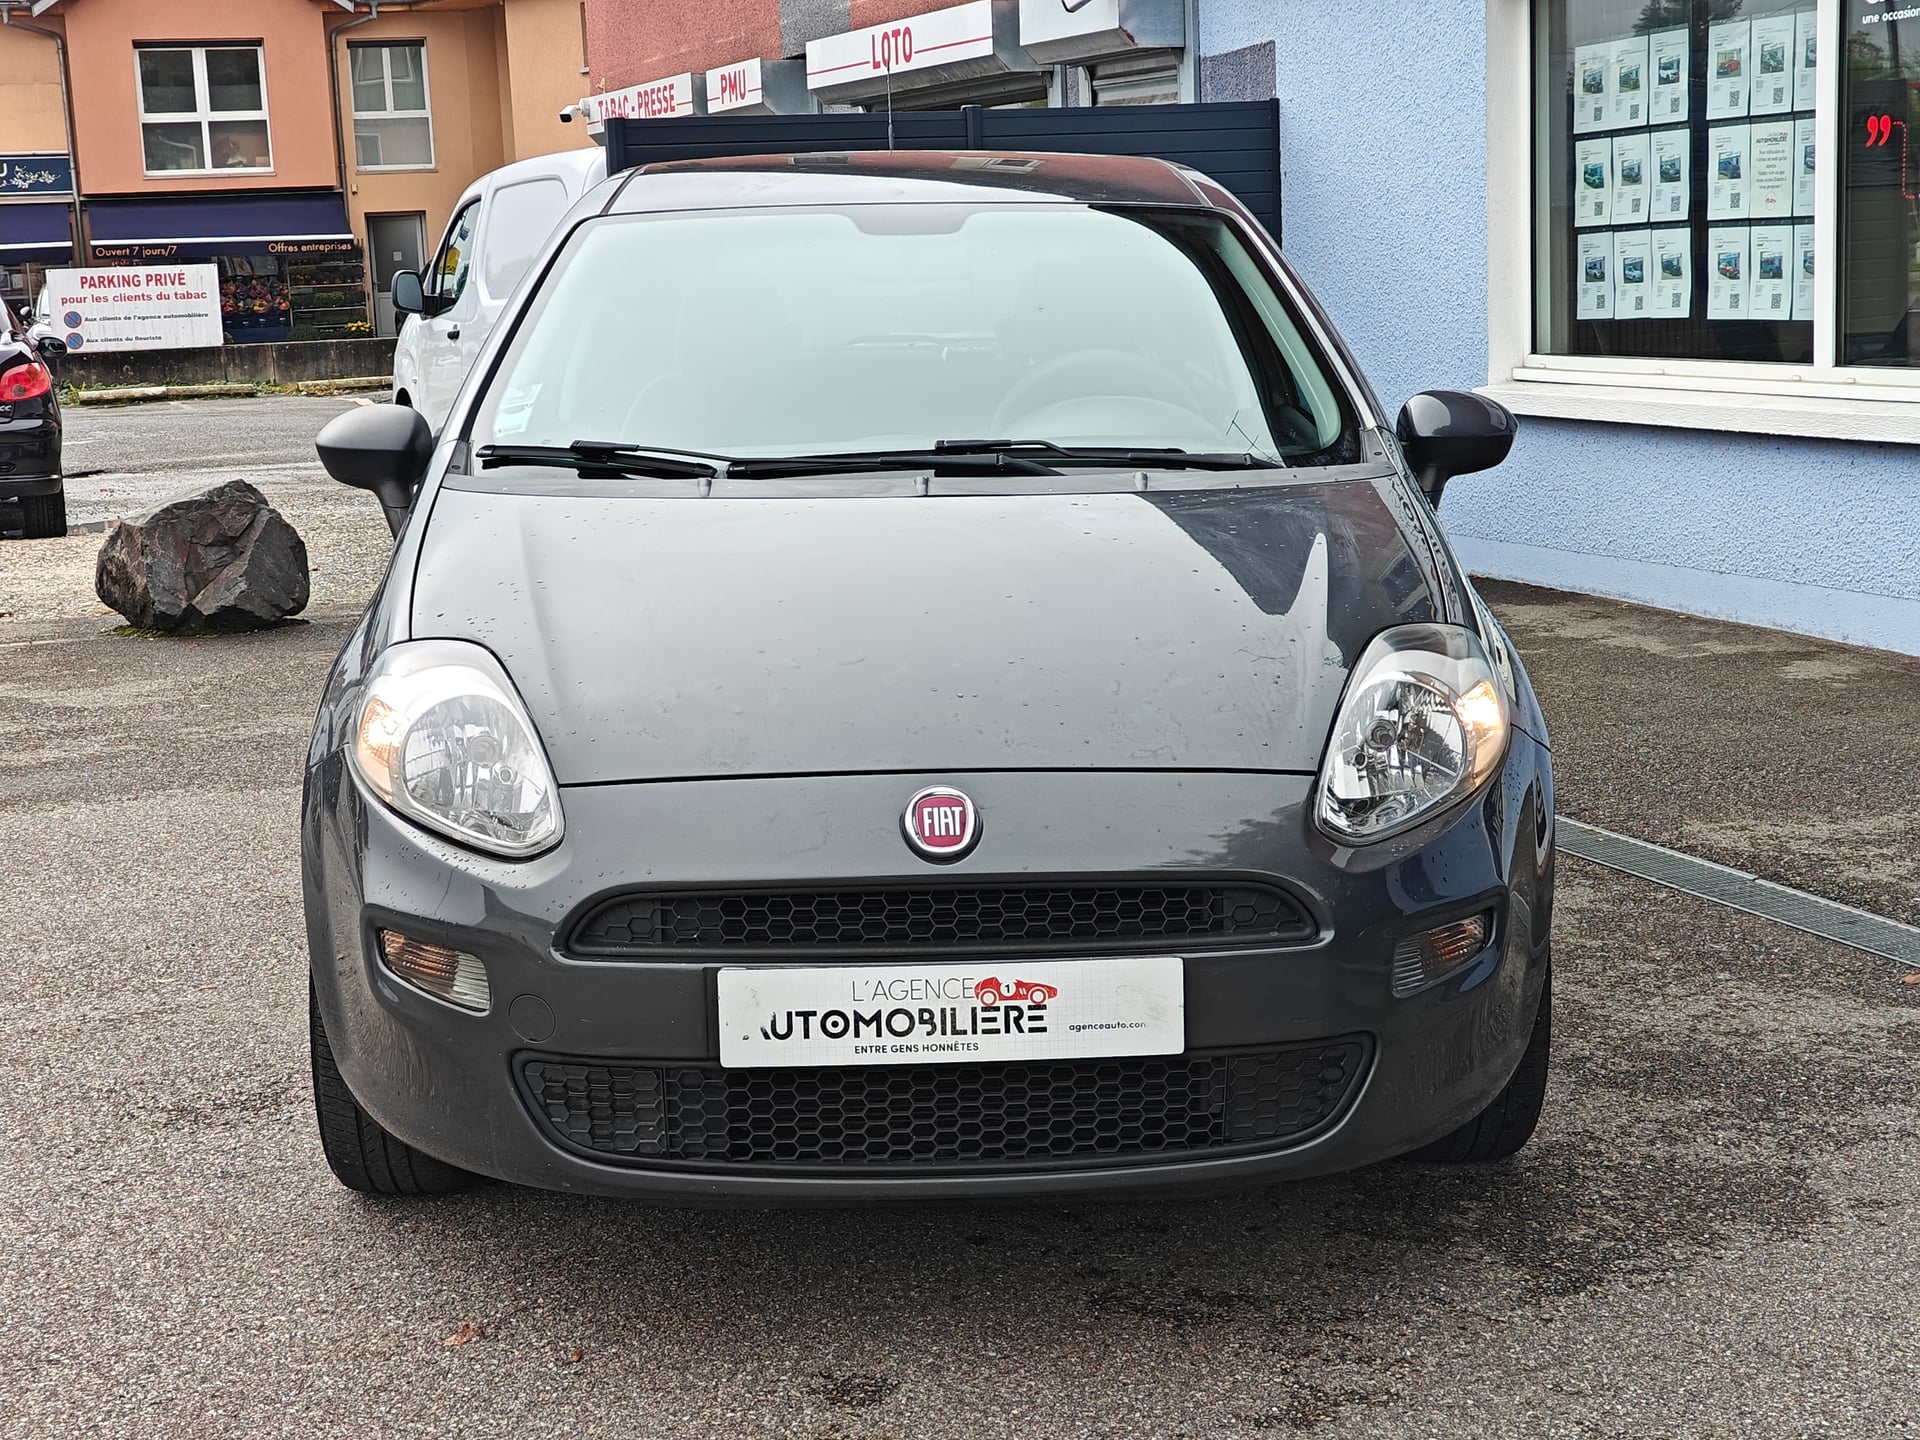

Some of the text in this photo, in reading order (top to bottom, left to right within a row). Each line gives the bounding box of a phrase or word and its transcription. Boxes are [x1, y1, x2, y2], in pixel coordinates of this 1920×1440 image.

[1862, 14, 1880, 24] une
[871, 26, 912, 70] LOTO
[721, 69, 746, 104] PMU
[637, 83, 676, 118] PRESSE
[95, 245, 178, 257] Ouvert 7 jours/7
[268, 242, 352, 253] Offres entreprises
[80, 269, 187, 290] PARKING PRIVÉ
[61, 290, 208, 306] pour les clients du tabac
[922, 806, 963, 837] FIAT
[852, 978, 975, 1001] L'AGENCE
[742, 1004, 1048, 1041] UTOMOBILIERE
[854, 1041, 979, 1054] ENTRE GENS HONNÊTES
